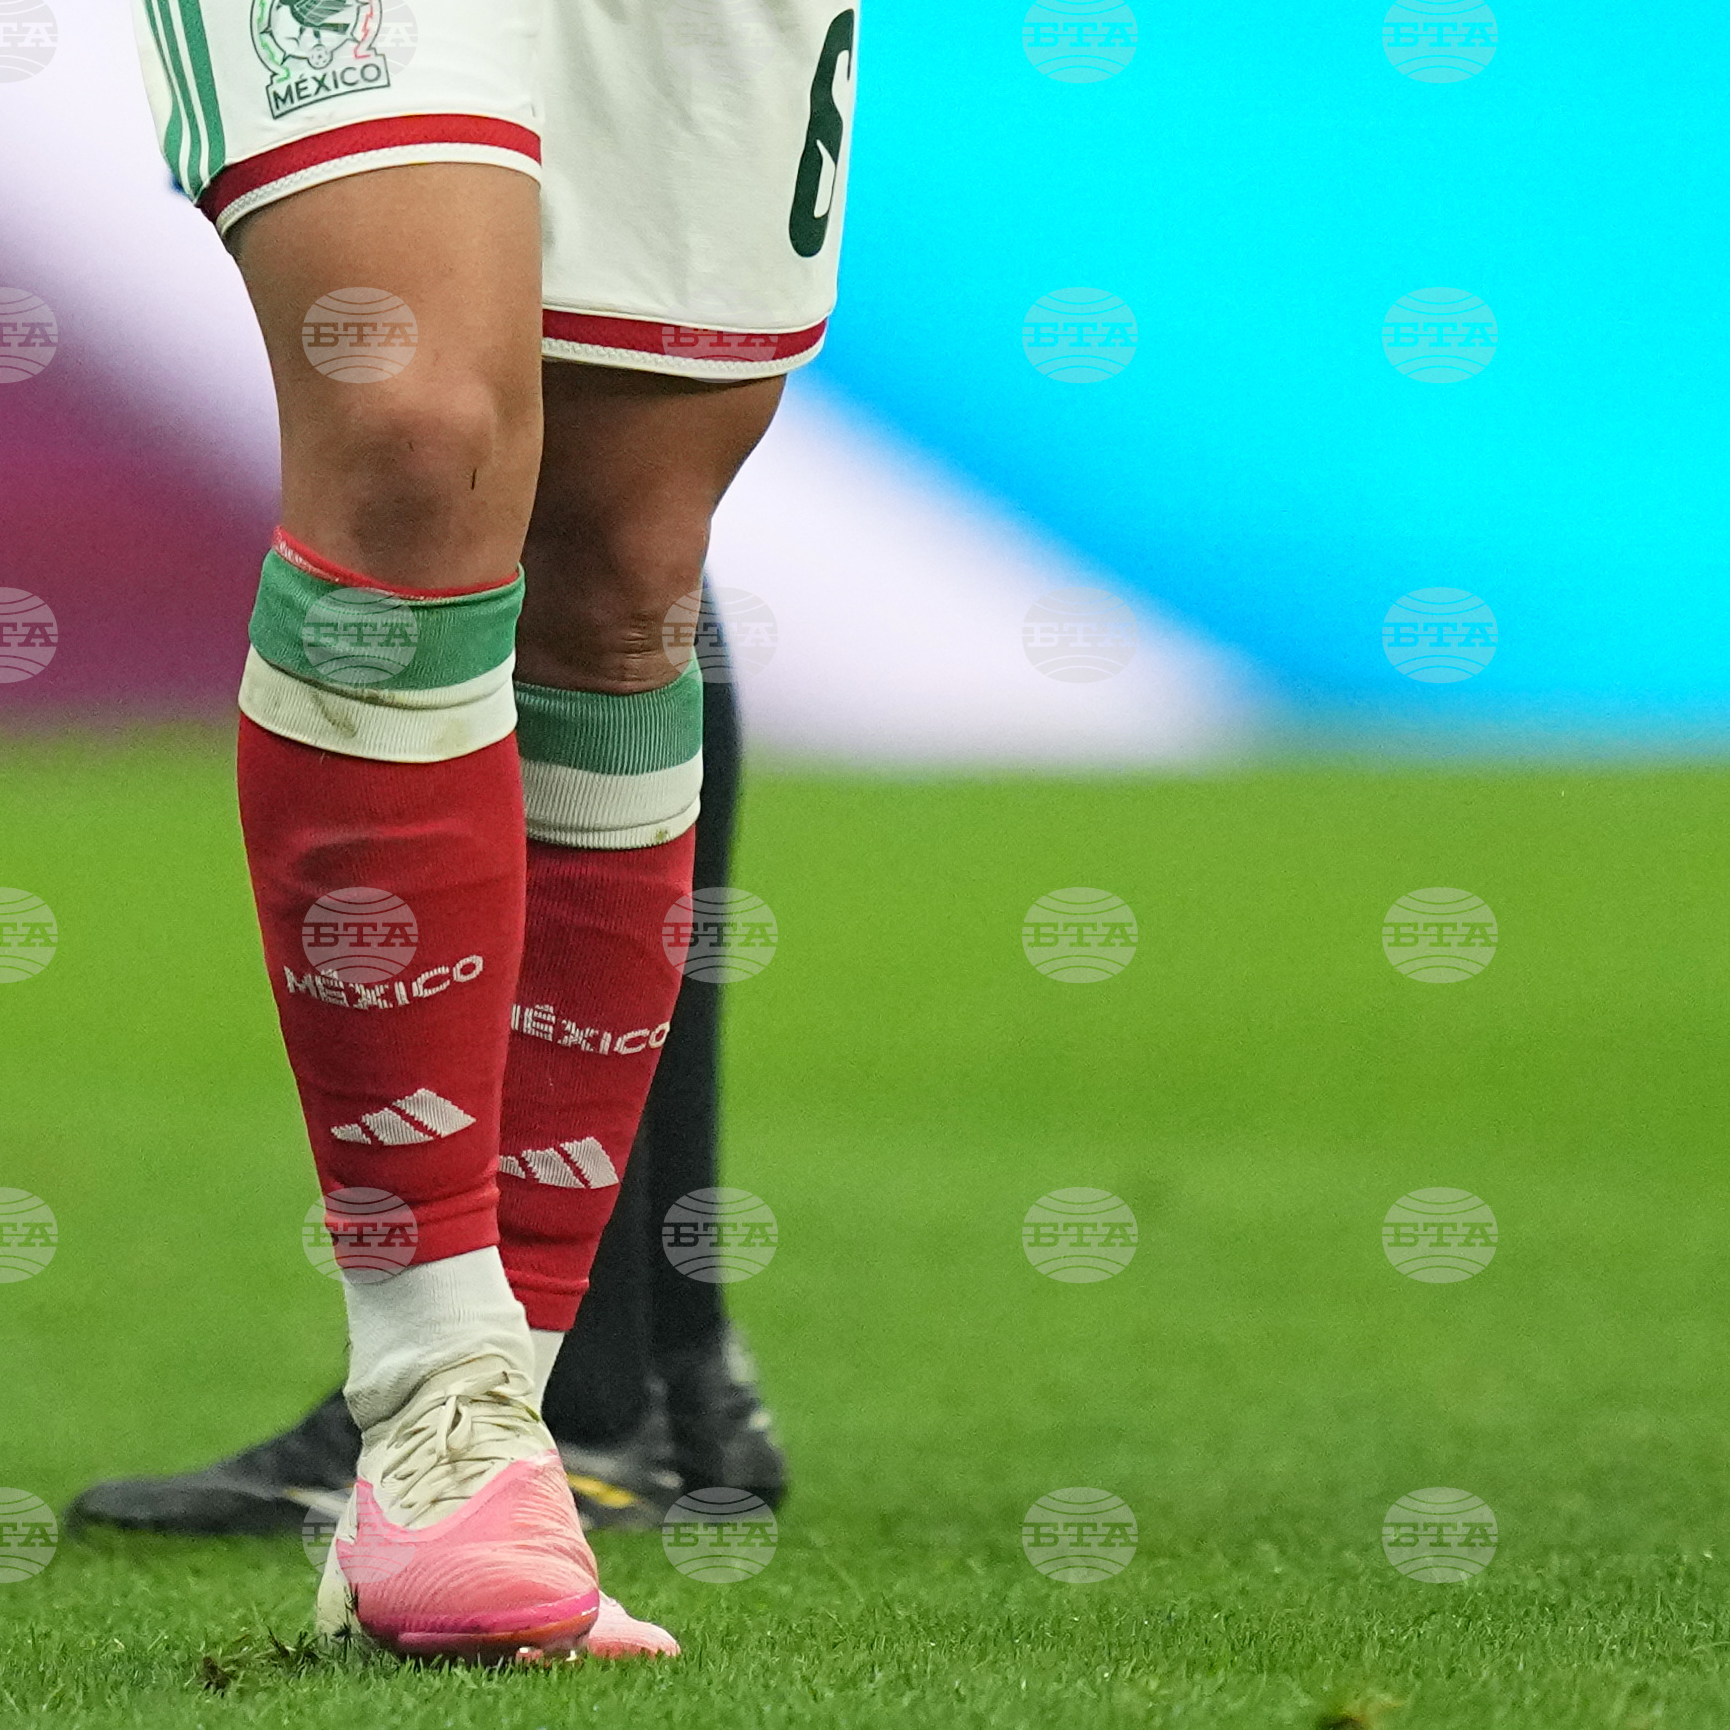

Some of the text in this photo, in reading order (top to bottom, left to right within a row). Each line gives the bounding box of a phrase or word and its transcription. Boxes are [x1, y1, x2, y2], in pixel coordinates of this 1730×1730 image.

[272, 63, 382, 111] MÉXICO
[788, 8, 855, 258] 6
[283, 954, 484, 1011] MÉXICO
